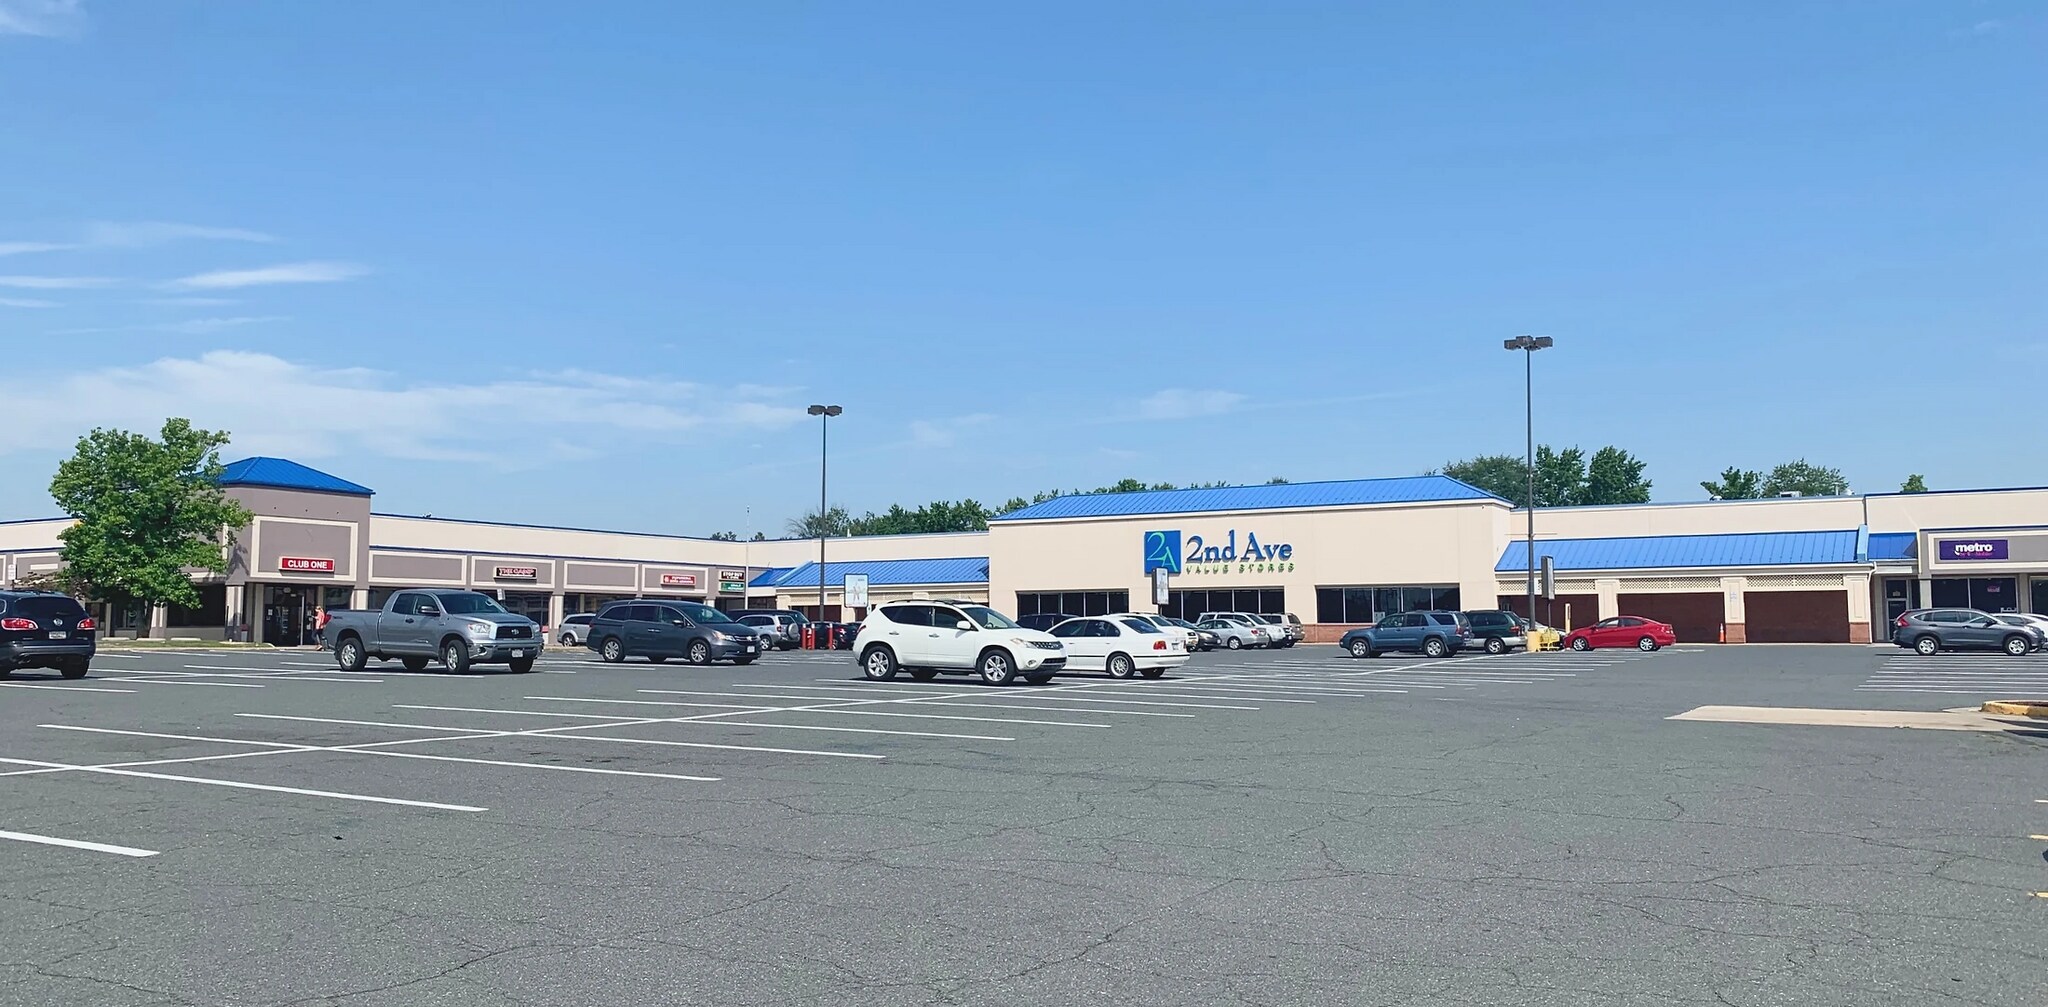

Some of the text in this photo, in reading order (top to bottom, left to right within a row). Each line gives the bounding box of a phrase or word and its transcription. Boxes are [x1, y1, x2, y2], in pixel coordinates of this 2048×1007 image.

[1186, 529, 1293, 565] 2nd Ave
[1955, 543, 1993, 554] metro
[287, 559, 328, 569] CLUB ONE
[1185, 563, 1295, 575] VALUE STORES
